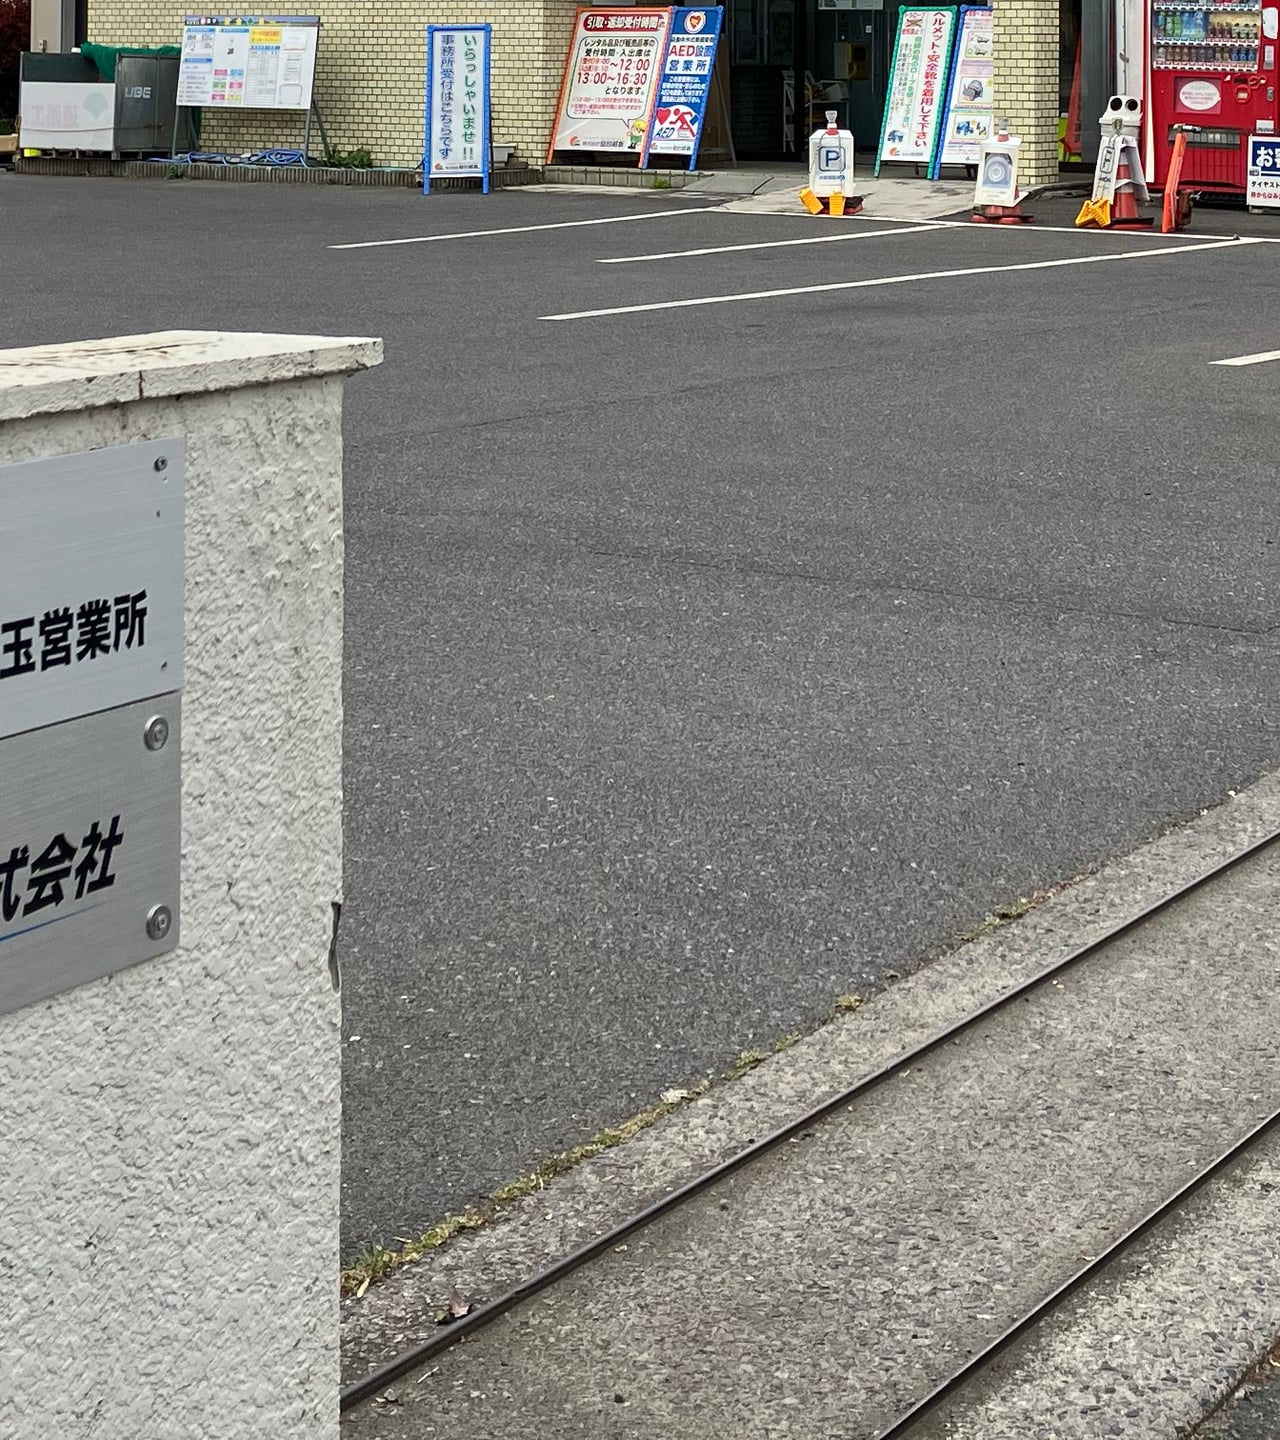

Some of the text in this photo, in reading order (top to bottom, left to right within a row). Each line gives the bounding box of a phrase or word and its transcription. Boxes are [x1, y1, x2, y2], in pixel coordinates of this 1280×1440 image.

[668, 60, 707, 72] 営業所
[439, 35, 456, 160] 事務所受付はこちらです
[655, 127, 675, 138] AED
[826, 150, 840, 167] P
